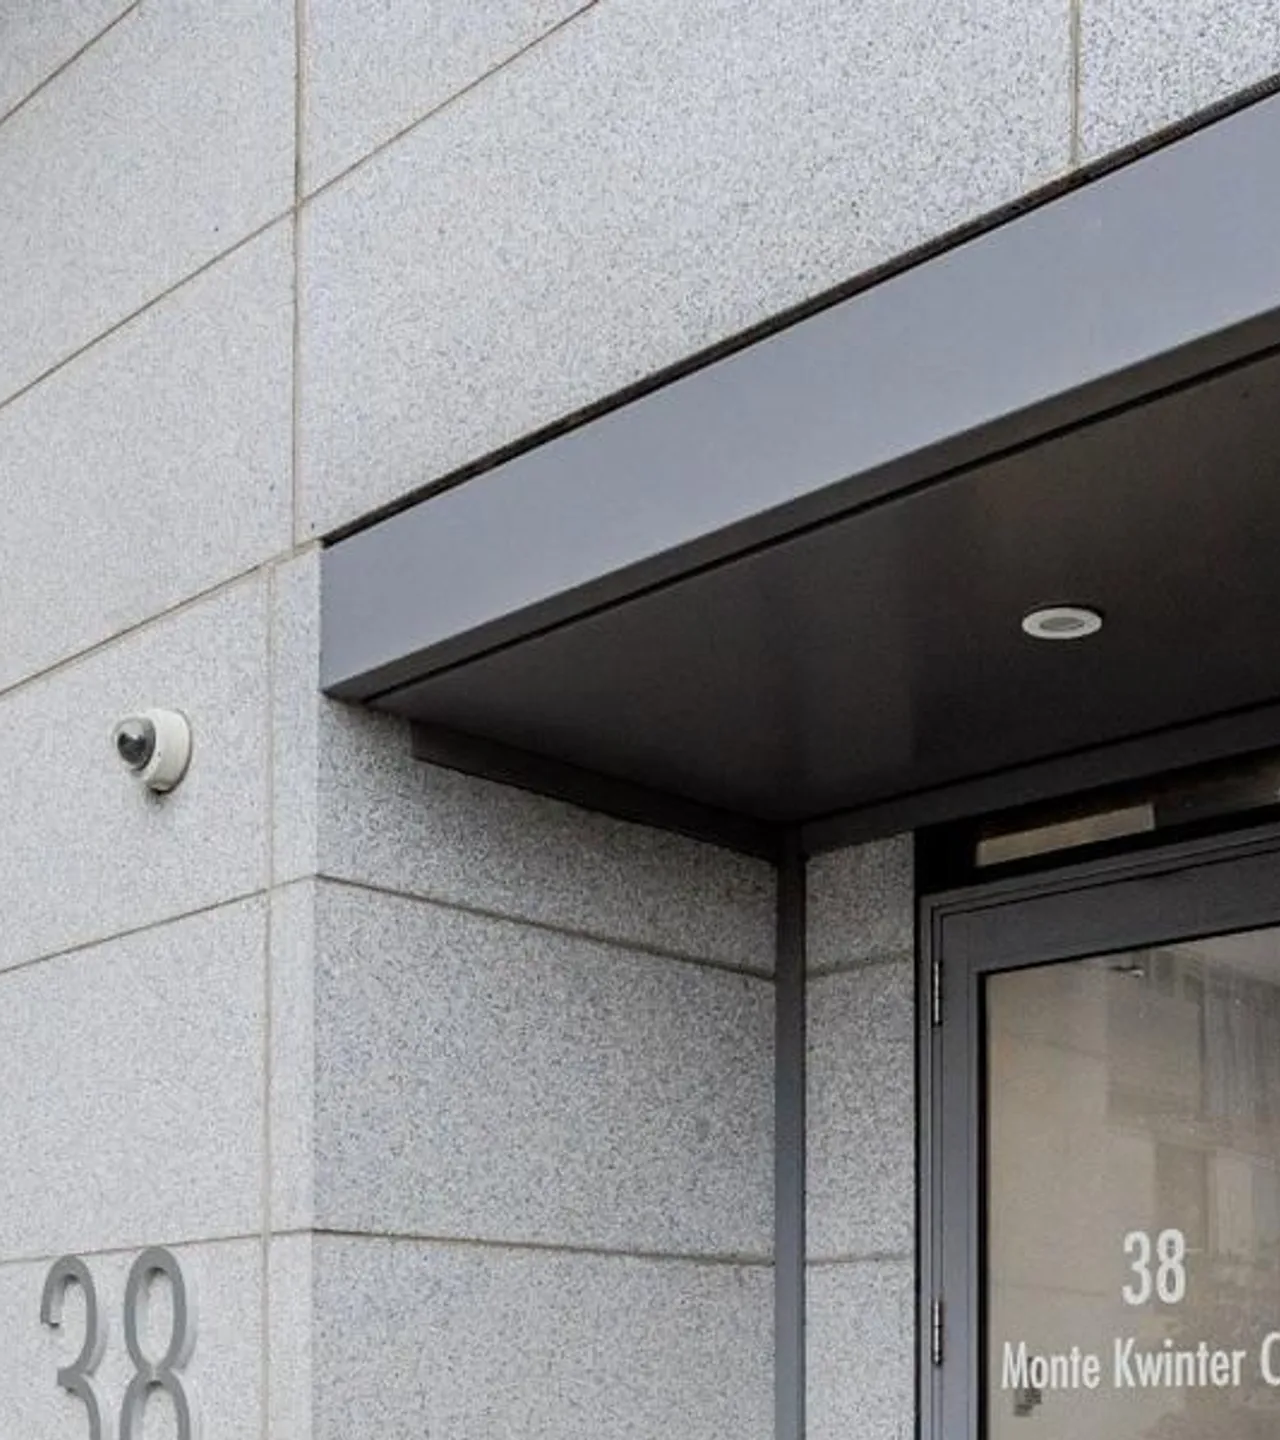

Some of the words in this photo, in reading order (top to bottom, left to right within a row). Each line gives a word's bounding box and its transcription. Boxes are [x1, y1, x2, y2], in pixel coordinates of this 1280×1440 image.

[1122, 1228, 1186, 1305] 38
[1001, 1340, 1100, 1389] Monte
[1114, 1337, 1246, 1388] Kwinter
